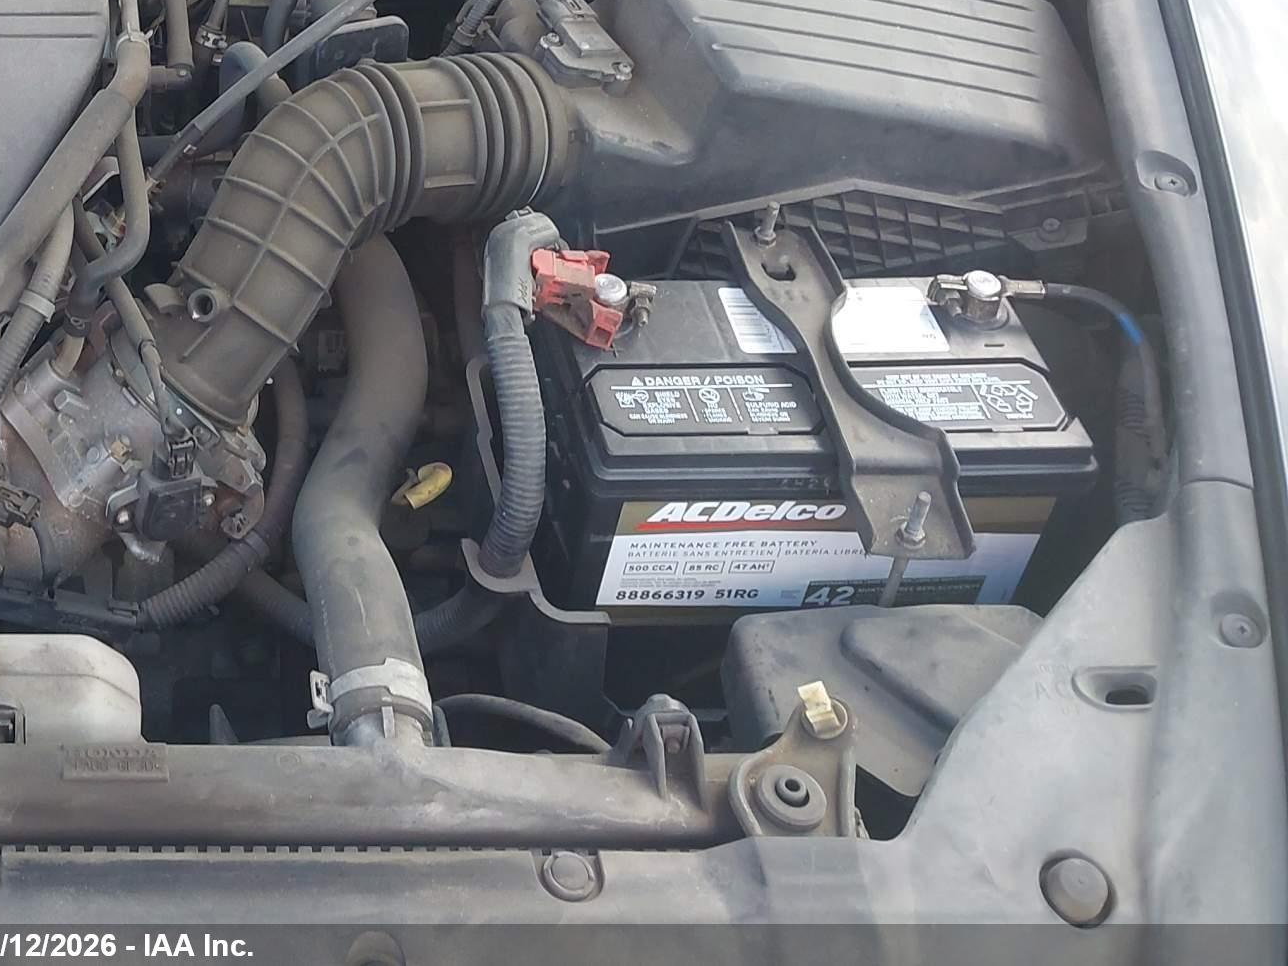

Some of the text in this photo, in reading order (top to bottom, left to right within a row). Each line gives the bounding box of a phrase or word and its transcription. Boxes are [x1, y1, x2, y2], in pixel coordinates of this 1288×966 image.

[644, 376, 701, 385] DANGER
[715, 375, 765, 385] POISON
[647, 500, 847, 522] ACDelco
[630, 539, 817, 549] MAINTENANCE FREE BATTERY
[627, 550, 677, 558] BATTERIE
[714, 549, 774, 557] ENTRETIEN
[616, 589, 759, 600] 88866319 51RG
[804, 586, 854, 605] 42
